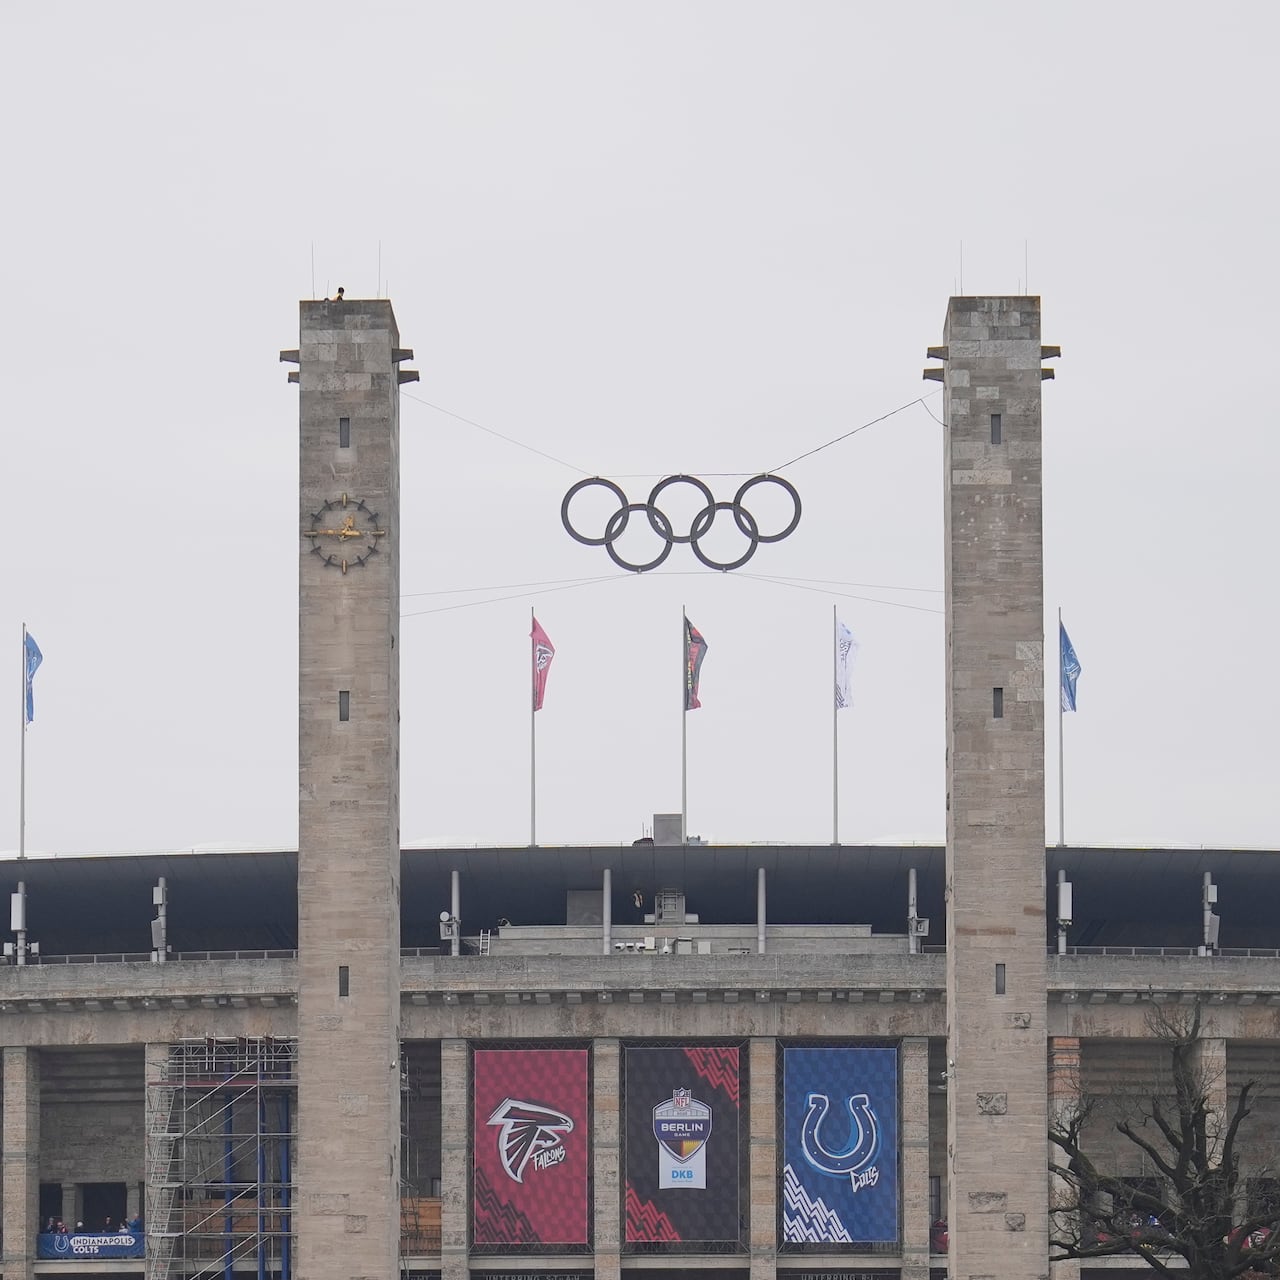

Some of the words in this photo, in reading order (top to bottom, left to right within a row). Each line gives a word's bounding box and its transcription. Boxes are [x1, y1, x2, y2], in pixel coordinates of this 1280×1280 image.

[661, 1123, 704, 1132] BERLIN
[671, 1170, 694, 1179] DKB
[72, 1236, 133, 1246] INDIANAPOLIS
[72, 1245, 99, 1254] COLTS
